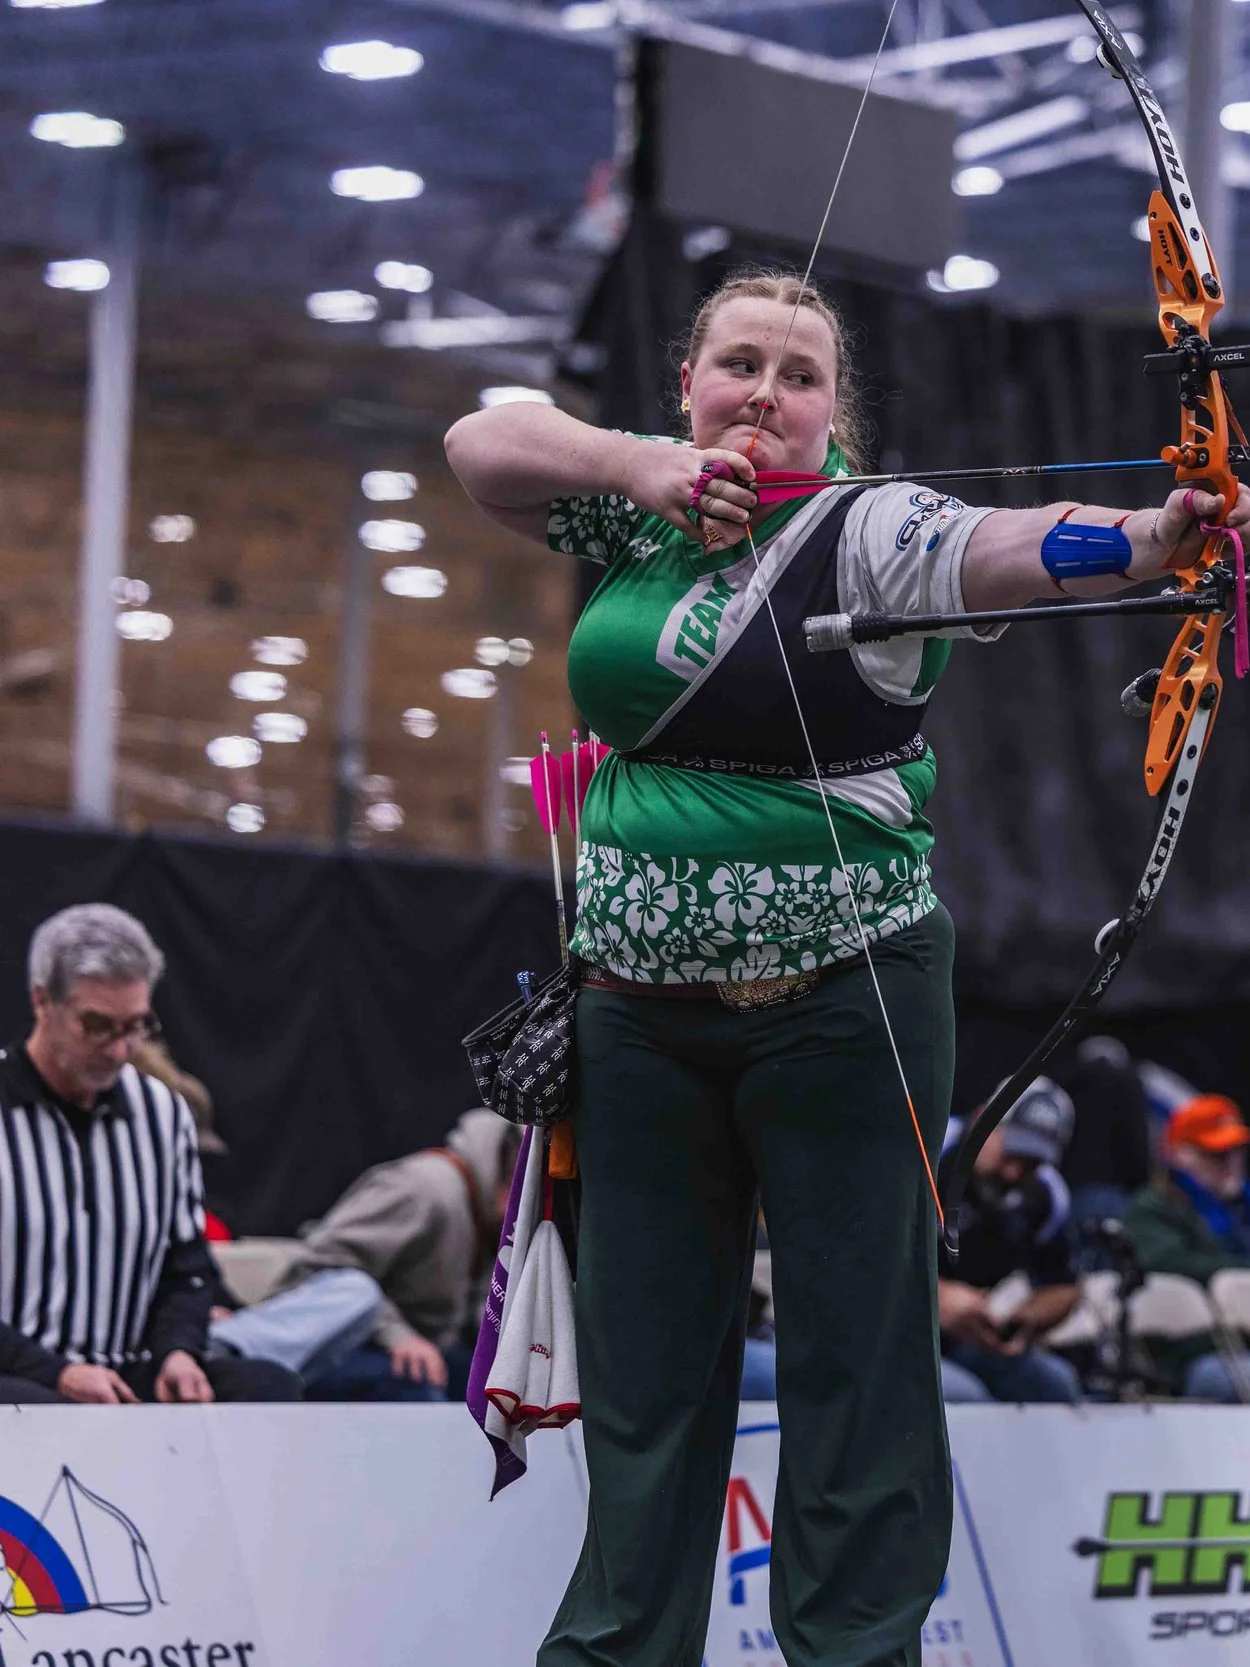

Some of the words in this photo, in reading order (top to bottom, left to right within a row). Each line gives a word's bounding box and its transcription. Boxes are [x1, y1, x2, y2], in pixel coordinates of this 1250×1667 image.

[1134, 79, 1185, 184] HOYT
[1157, 229, 1173, 266] HOYT
[1213, 352, 1245, 362] AXCEL
[674, 572, 739, 669] TEAM
[827, 750, 901, 774] SPIGA
[0, 1638, 255, 1667] ancaster
